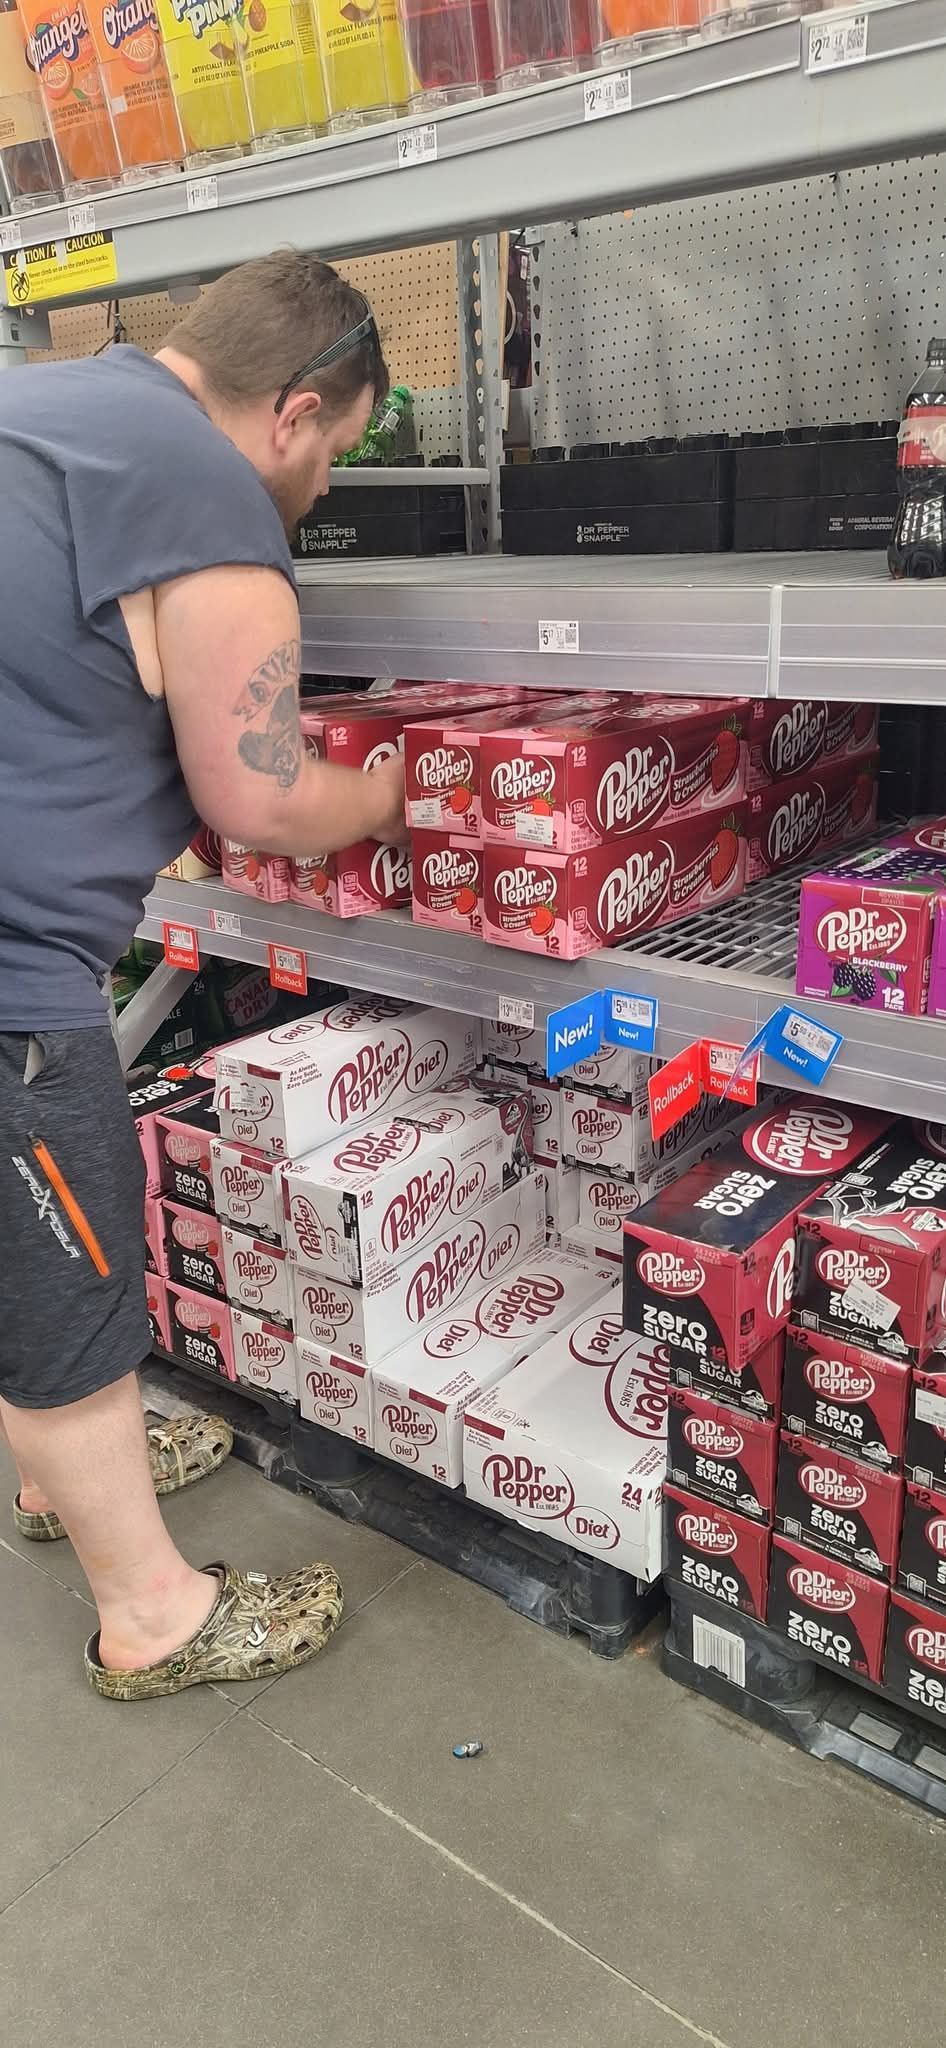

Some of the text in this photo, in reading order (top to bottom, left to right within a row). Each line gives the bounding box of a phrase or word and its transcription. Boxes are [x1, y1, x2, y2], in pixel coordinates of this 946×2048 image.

[10, 247, 45, 266] CTION
[307, 527, 356, 539] DR PEPPER
[583, 525, 630, 534] DR PEPPER
[583, 534, 621, 542] SNAPPLE
[308, 539, 349, 550] SNAPPLE
[329, 727, 347, 740] 12
[434, 748, 455, 765] Dr
[572, 745, 587, 762] 12
[416, 749, 469, 787] Pepper
[512, 758, 535, 777] Dr
[625, 746, 653, 789] Dr
[673, 740, 719, 790] Strawberries
[491, 763, 550, 800] Pepper
[682, 773, 706, 799] Cream
[597, 754, 669, 831] Pepper
[463, 813, 478, 828] 12
[423, 851, 474, 887] Pepper
[441, 850, 461, 867] Dr
[572, 857, 588, 872] 12
[673, 845, 719, 890] Strawberries
[516, 866, 536, 886] Dr
[626, 850, 653, 892] Dr
[495, 870, 552, 908] Pepper
[598, 856, 670, 934] Pepper
[682, 872, 705, 898] Cream
[322, 896, 333, 909] 12
[468, 914, 483, 928] 12
[502, 909, 537, 924] Strawberries
[509, 918, 526, 929] Cream
[848, 907, 879, 932] Dr
[544, 935, 560, 950] 12
[817, 911, 899, 955] Pepper
[169, 951, 194, 964] Rollback
[852, 956, 908, 973] BLACKBERRY
[275, 973, 302, 988] Rollback
[882, 986, 905, 1004] 12
[555, 1021, 593, 1052] New!
[618, 1027, 639, 1041] New!
[356, 1040, 385, 1082] Dr
[784, 1046, 808, 1068] New!
[289, 1075, 302, 1083] Zero
[298, 1063, 317, 1075] Always,
[414, 1050, 441, 1087] Diet
[578, 1064, 595, 1075] Diet
[287, 1072, 323, 1090] Zero Calories
[328, 1043, 406, 1125] Pepper
[564, 1091, 575, 1101] 12
[653, 1071, 694, 1114] Rollback
[572, 1109, 618, 1136] Pepper
[587, 1109, 606, 1123] Dr
[237, 1123, 253, 1135] Diet
[270, 1137, 284, 1149] 12
[580, 1145, 597, 1155] Diet
[175, 1169, 207, 1193] zero
[406, 1168, 433, 1199] Dr
[456, 1170, 480, 1208] Diet
[606, 1182, 625, 1194] Dr
[693, 1170, 753, 1210] SUGAR
[176, 1183, 208, 1203] SUGAR
[361, 1190, 374, 1204] 12
[589, 1182, 638, 1211] Pepper
[716, 1173, 777, 1217] zero
[232, 1202, 246, 1212] Diet
[381, 1170, 450, 1254] Pepper
[599, 1217, 616, 1227] Diet
[804, 1221, 821, 1235] 12
[488, 1234, 512, 1273] Diet
[661, 1252, 685, 1271] Dr
[843, 1250, 869, 1268] Dr
[182, 1254, 214, 1275] zero
[639, 1252, 700, 1288] Pepper
[818, 1250, 884, 1286] Pepper
[183, 1266, 215, 1286] SUGAR
[406, 1234, 480, 1323] Pepper
[243, 1288, 258, 1299] Diet
[303, 1286, 350, 1319] Pepper
[319, 1286, 337, 1302] Dr
[233, 1312, 242, 1322] 12
[643, 1303, 708, 1341] zero
[829, 1304, 880, 1331] SUGAR
[315, 1326, 331, 1337] Diet
[588, 1318, 625, 1356] Diet
[643, 1322, 708, 1357] SUGAR
[185, 1334, 217, 1357] zero
[349, 1343, 363, 1354] 12
[186, 1347, 217, 1368] SUGAR
[252, 1367, 266, 1378] Diet
[323, 1371, 340, 1387] Dr
[700, 1363, 742, 1388] SUGAR
[807, 1359, 870, 1397] Pepper
[830, 1360, 854, 1380] Dr
[306, 1371, 353, 1402] Pepper
[619, 1375, 639, 1410] Est.1885
[319, 1408, 335, 1420] Diet
[382, 1404, 433, 1436] Pepper
[399, 1406, 420, 1422] Dr
[815, 1401, 864, 1430] zero
[353, 1425, 367, 1438] 12
[685, 1418, 739, 1451] Pepper
[704, 1419, 725, 1436] Dr
[815, 1417, 863, 1440] SUGAR
[396, 1444, 412, 1457] Diet
[432, 1464, 446, 1478] 12
[514, 1456, 546, 1483] Dr
[695, 1454, 738, 1482] zero
[823, 1467, 846, 1488] Dr
[483, 1454, 567, 1509] Pepper
[695, 1469, 737, 1493] SUGAR
[801, 1465, 862, 1502] Pepper
[622, 1483, 642, 1505] 24
[622, 1500, 641, 1512] PACK
[576, 1517, 609, 1540] Diet
[698, 1513, 719, 1532] Dr
[811, 1503, 857, 1534] zero
[677, 1512, 733, 1548] Pepper
[811, 1519, 857, 1546] SUGAR
[682, 1555, 740, 1593] zero
[788, 1566, 851, 1603] Pepper
[812, 1569, 835, 1588] Dr
[682, 1573, 740, 1607] SUGAR
[788, 1610, 852, 1653] zero
[787, 1627, 851, 1668] SUGAR
